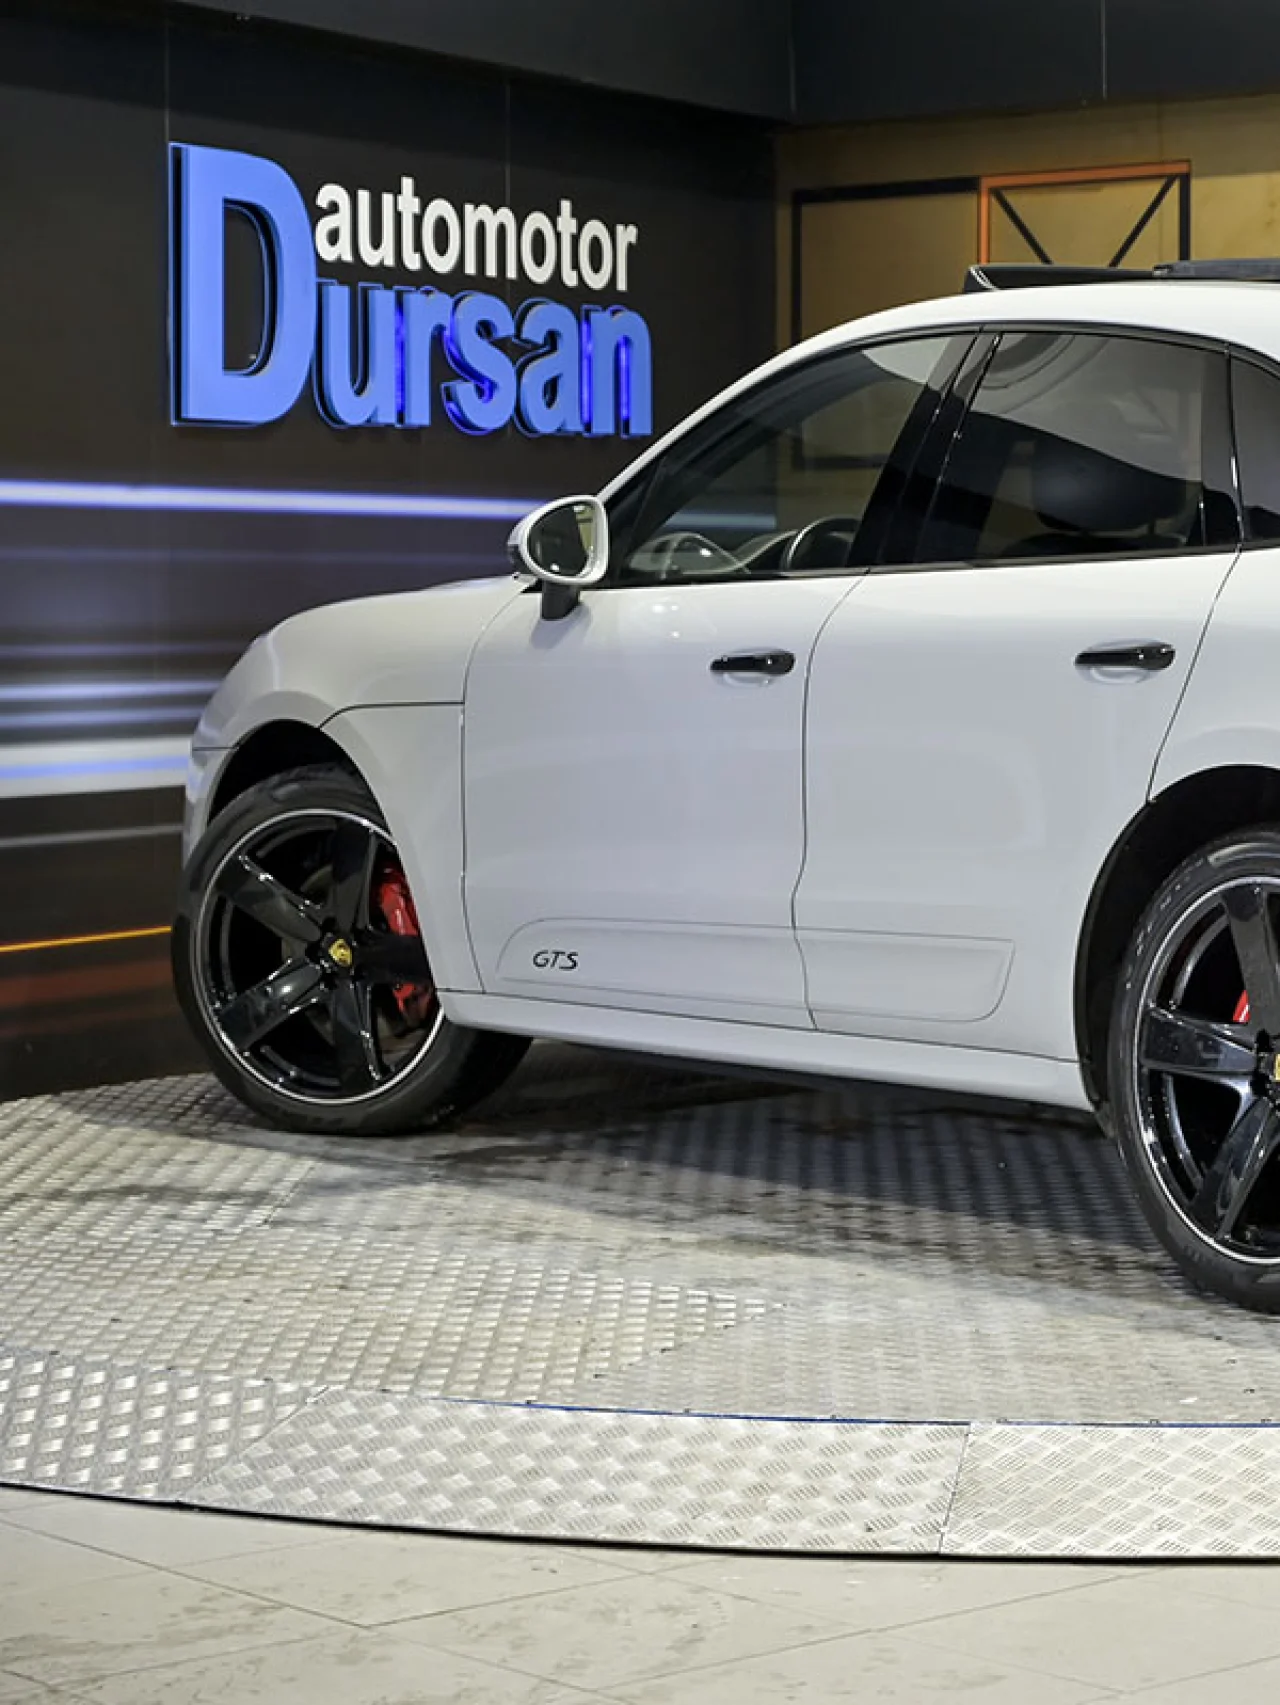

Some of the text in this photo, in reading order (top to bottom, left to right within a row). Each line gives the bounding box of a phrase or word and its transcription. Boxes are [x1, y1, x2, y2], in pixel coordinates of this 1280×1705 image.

[168, 141, 653, 438] Dursan
[315, 176, 639, 292] automotor
[532, 949, 579, 972] GTS
